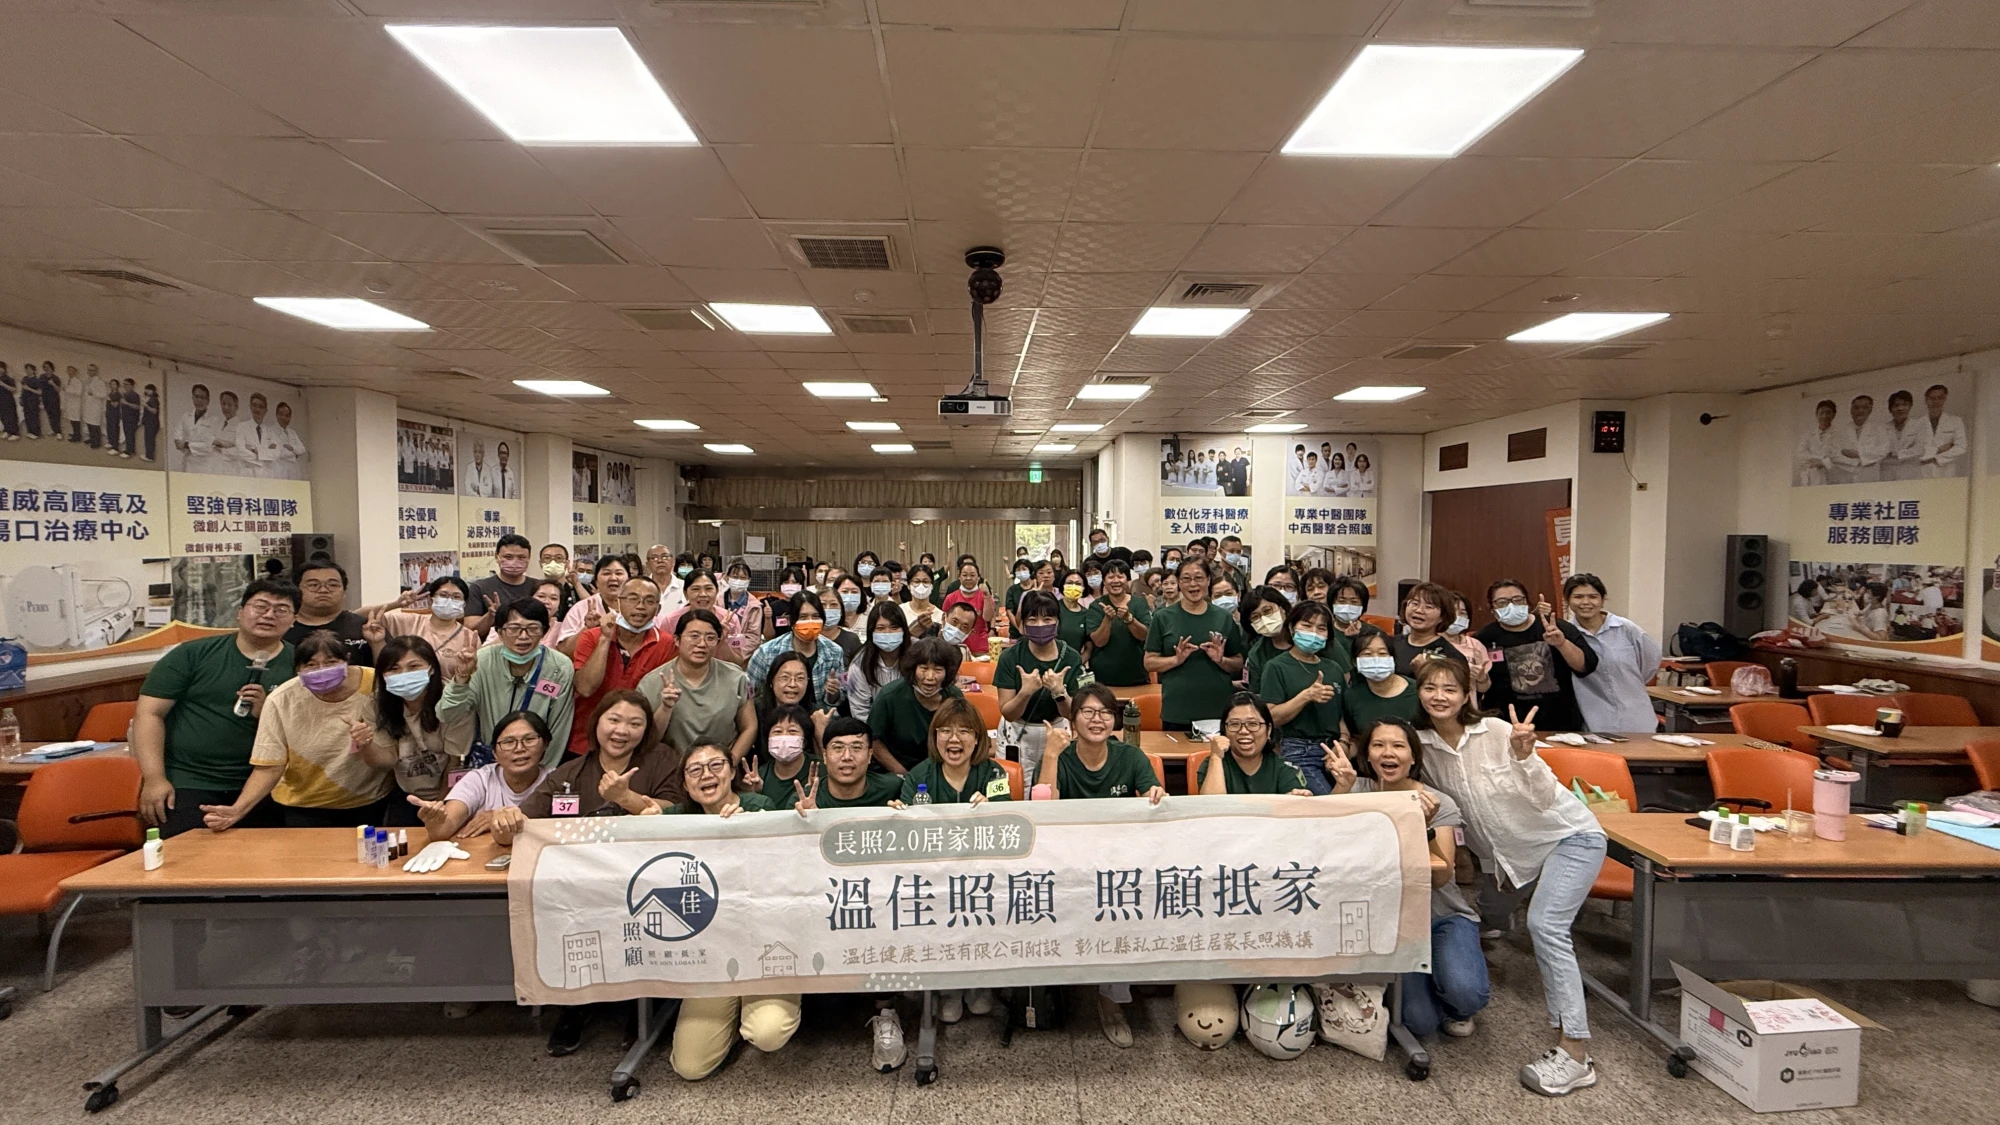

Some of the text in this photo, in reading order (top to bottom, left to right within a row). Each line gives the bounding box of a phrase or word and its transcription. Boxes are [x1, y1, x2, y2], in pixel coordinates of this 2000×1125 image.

[187, 495, 299, 517] 堅強骨科團隊
[1164, 507, 1249, 521] 數位化牙科醫療
[1293, 508, 1367, 521] 專業中醫團隊
[1828, 500, 1921, 521] 專業社區
[193, 519, 293, 533] 微創人工關節置換
[1170, 522, 1243, 535] 全人照護中心
[1288, 522, 1374, 536] 中西醫整合照護
[1827, 525, 1920, 546] 服務團隊
[542, 683, 556, 694] 63
[992, 782, 1004, 793] 36
[558, 801, 573, 813] 37
[834, 823, 1022, 856] 長照2.0居家服務
[679, 860, 702, 916] 溫佳
[825, 861, 1322, 931] 溫佳照顧 照顧抵家
[623, 921, 644, 967] 照顧
[842, 930, 1314, 966] 溫佳健康生活有限公司附設 彰化縣私立溫佳居家長照機構
